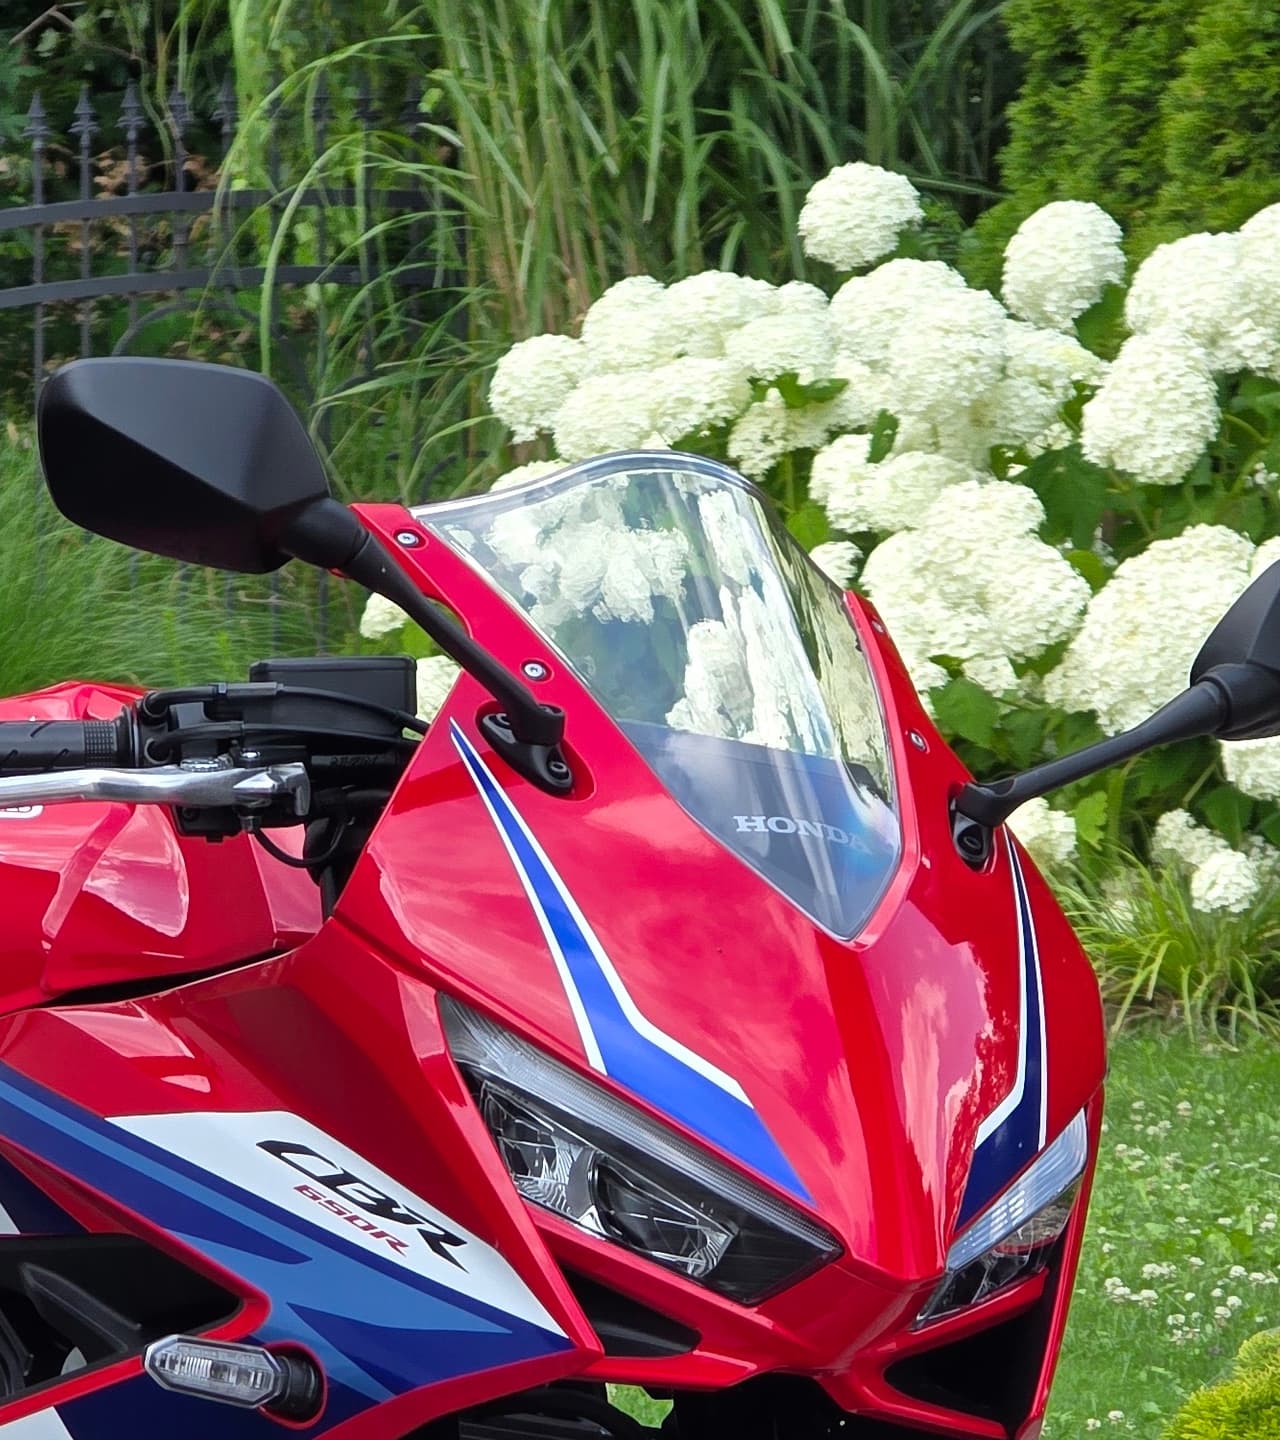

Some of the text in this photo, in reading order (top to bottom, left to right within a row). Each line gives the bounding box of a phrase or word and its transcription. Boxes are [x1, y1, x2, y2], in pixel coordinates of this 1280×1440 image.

[733, 815, 873, 855] HONDA
[256, 1140, 470, 1274] CBR
[293, 1184, 410, 1257] 650R
